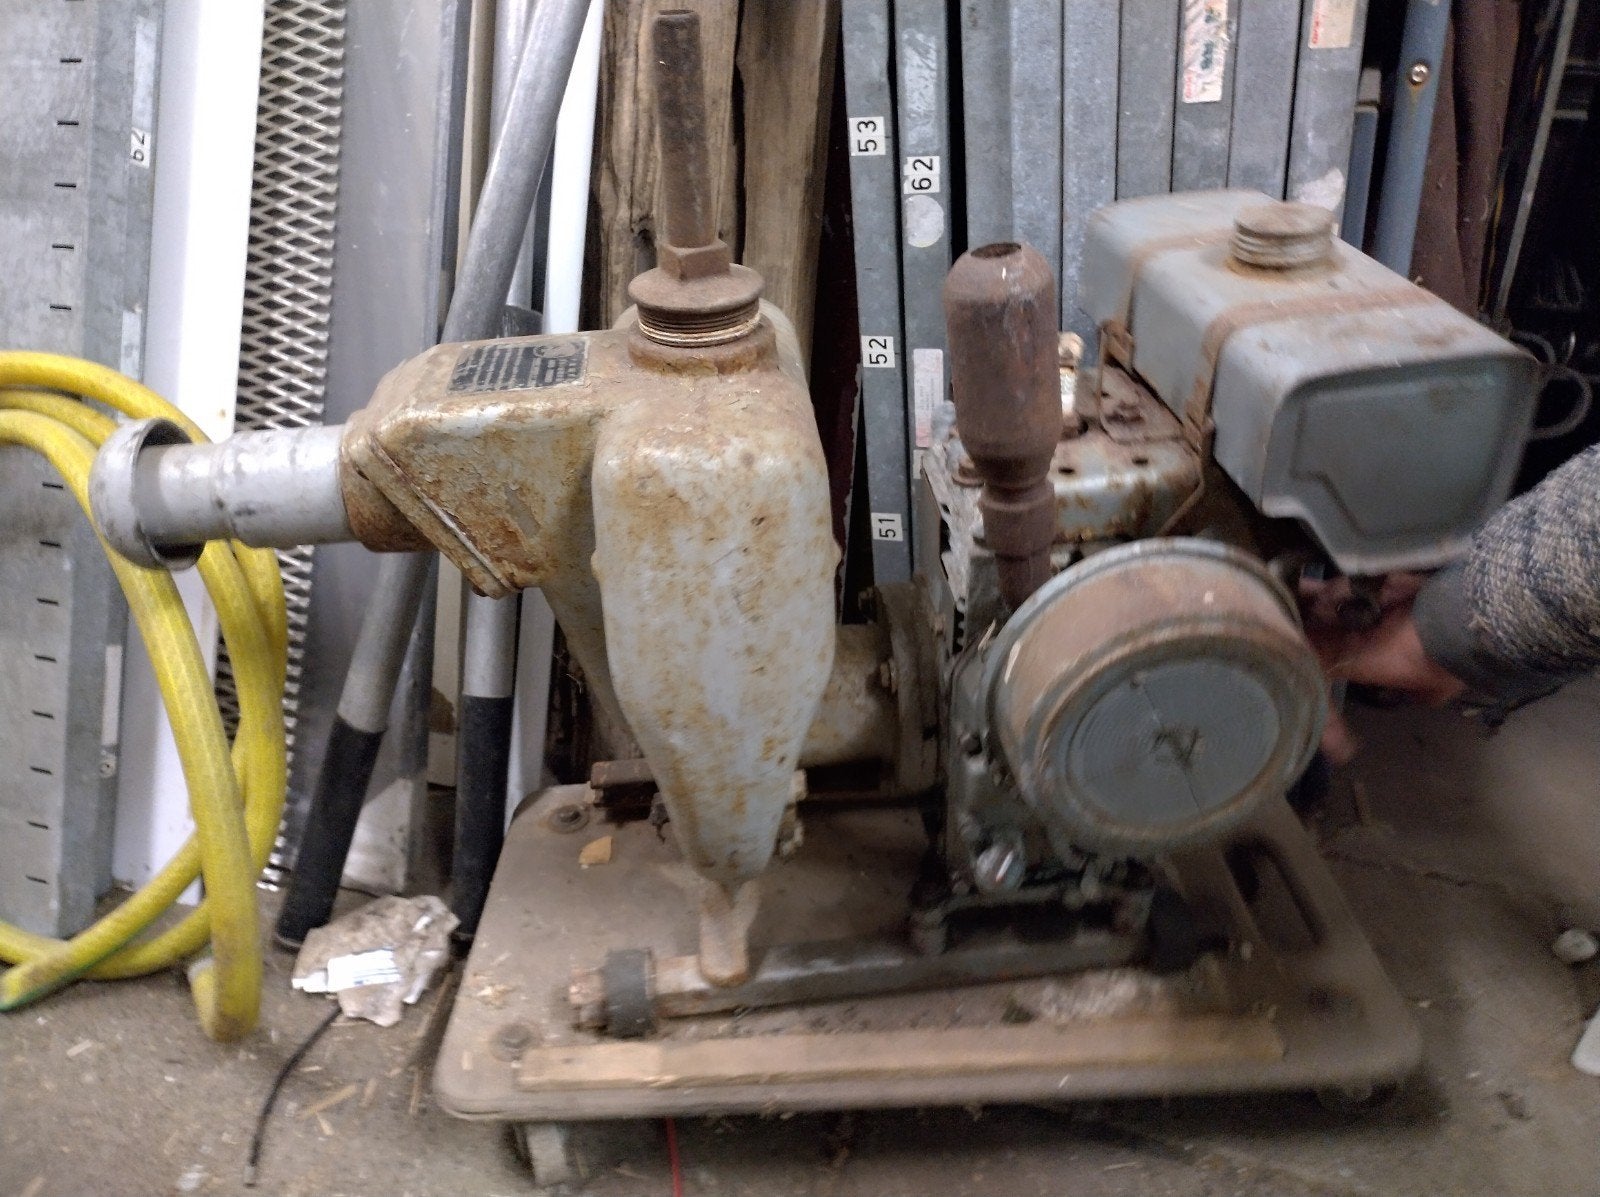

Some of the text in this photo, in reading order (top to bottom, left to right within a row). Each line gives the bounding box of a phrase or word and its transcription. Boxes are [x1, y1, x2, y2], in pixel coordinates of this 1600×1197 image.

[857, 120, 877, 152] 53
[912, 158, 933, 190] 62
[868, 338, 888, 364] 52
[878, 518, 896, 538] 51
